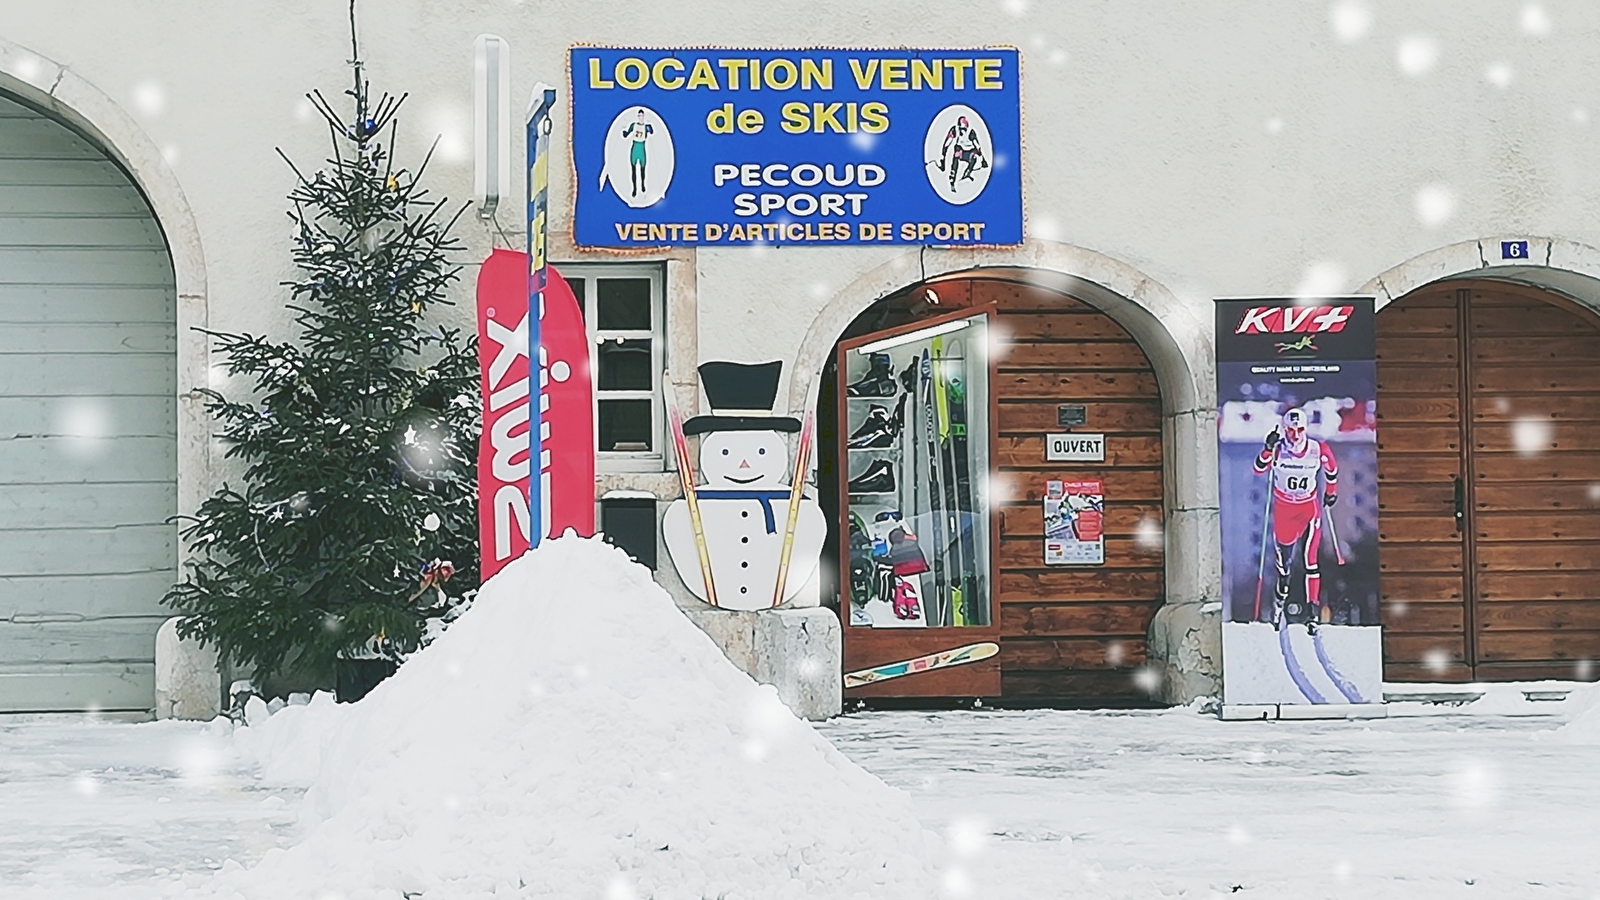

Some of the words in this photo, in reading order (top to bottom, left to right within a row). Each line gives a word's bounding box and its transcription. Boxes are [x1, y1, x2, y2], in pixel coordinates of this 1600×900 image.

[588, 57, 833, 91] LOCATION
[848, 58, 1004, 91] VENTE
[706, 102, 765, 134] de
[780, 102, 890, 134] SKIS
[714, 163, 887, 187] PECOUD
[733, 192, 869, 217] SPORT
[614, 222, 699, 241] VENTE
[704, 222, 851, 241] D'ARTICLES
[859, 222, 894, 241] DE
[900, 222, 986, 241] SPORT
[1509, 243, 1521, 258] 6
[1235, 306, 1349, 334] KV+
[1053, 440, 1102, 454] OUVERT
[1287, 476, 1309, 491] 64
